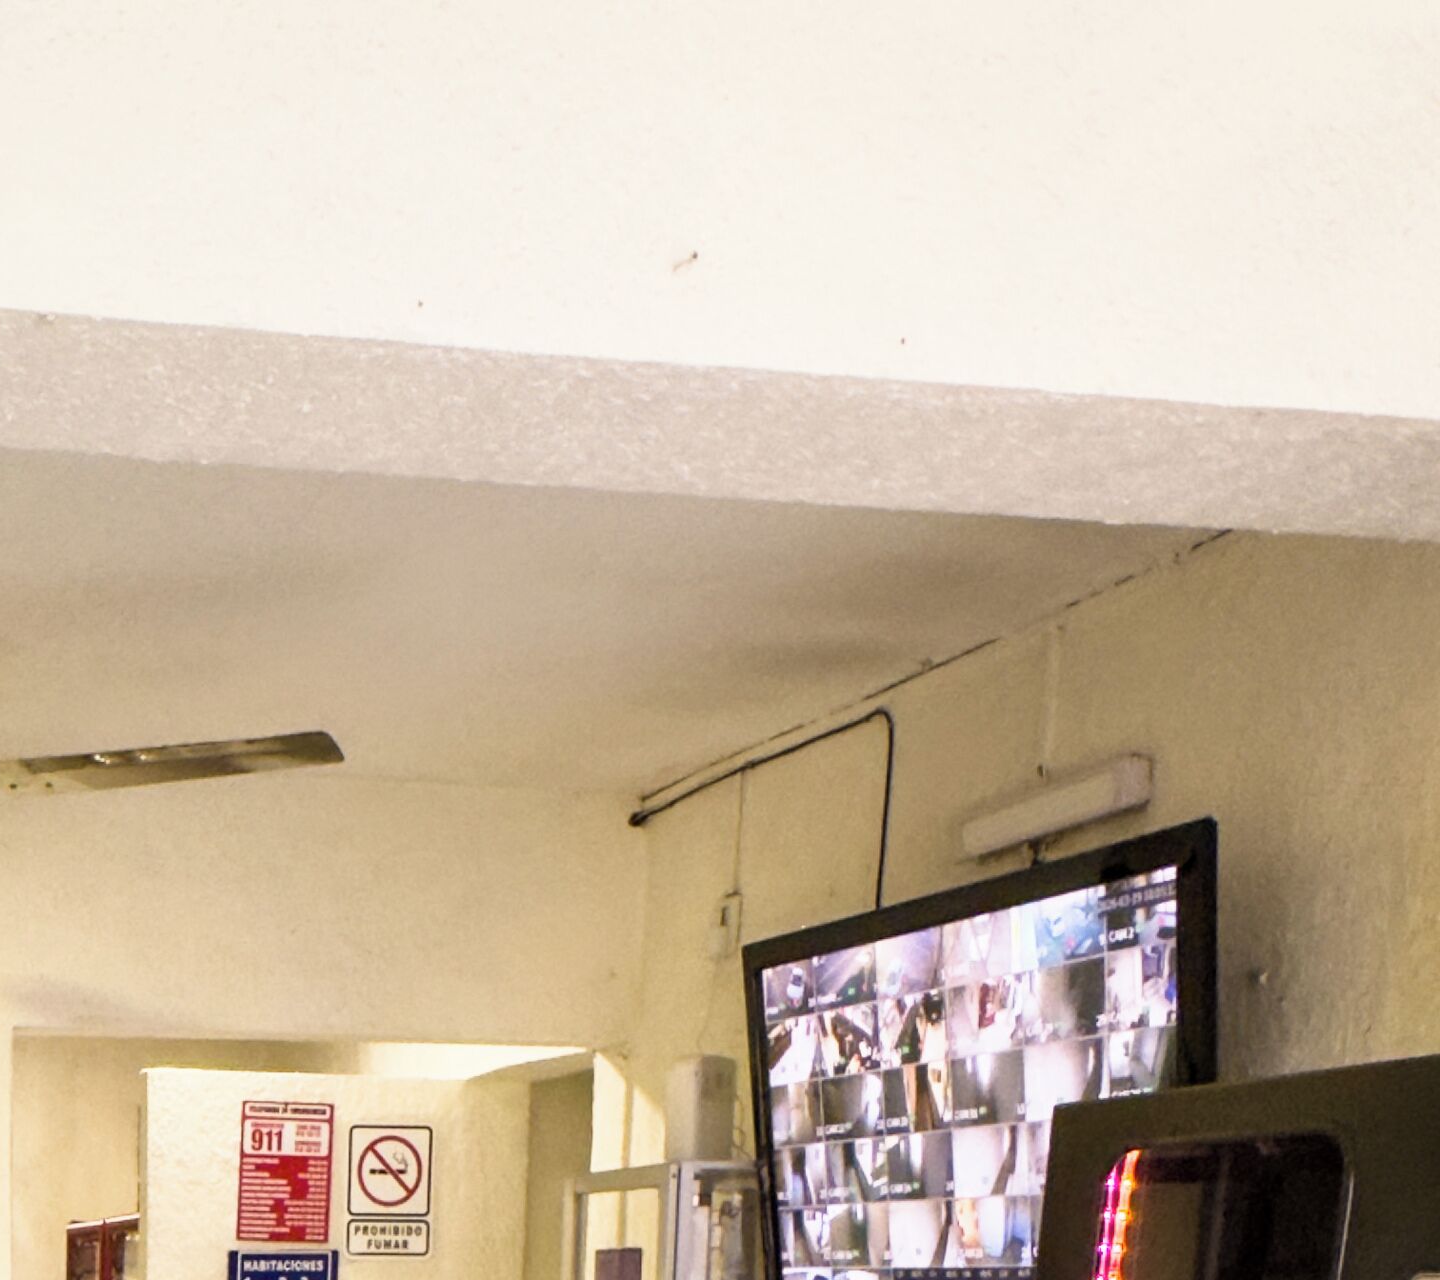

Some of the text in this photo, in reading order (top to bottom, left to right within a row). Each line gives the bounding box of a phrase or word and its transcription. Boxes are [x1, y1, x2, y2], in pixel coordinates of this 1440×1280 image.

[251, 1128, 283, 1152] 911
[354, 1225, 423, 1236] PROHIBIDO
[367, 1239, 409, 1250] FUMAR
[243, 1259, 324, 1272] HABITACIONES
